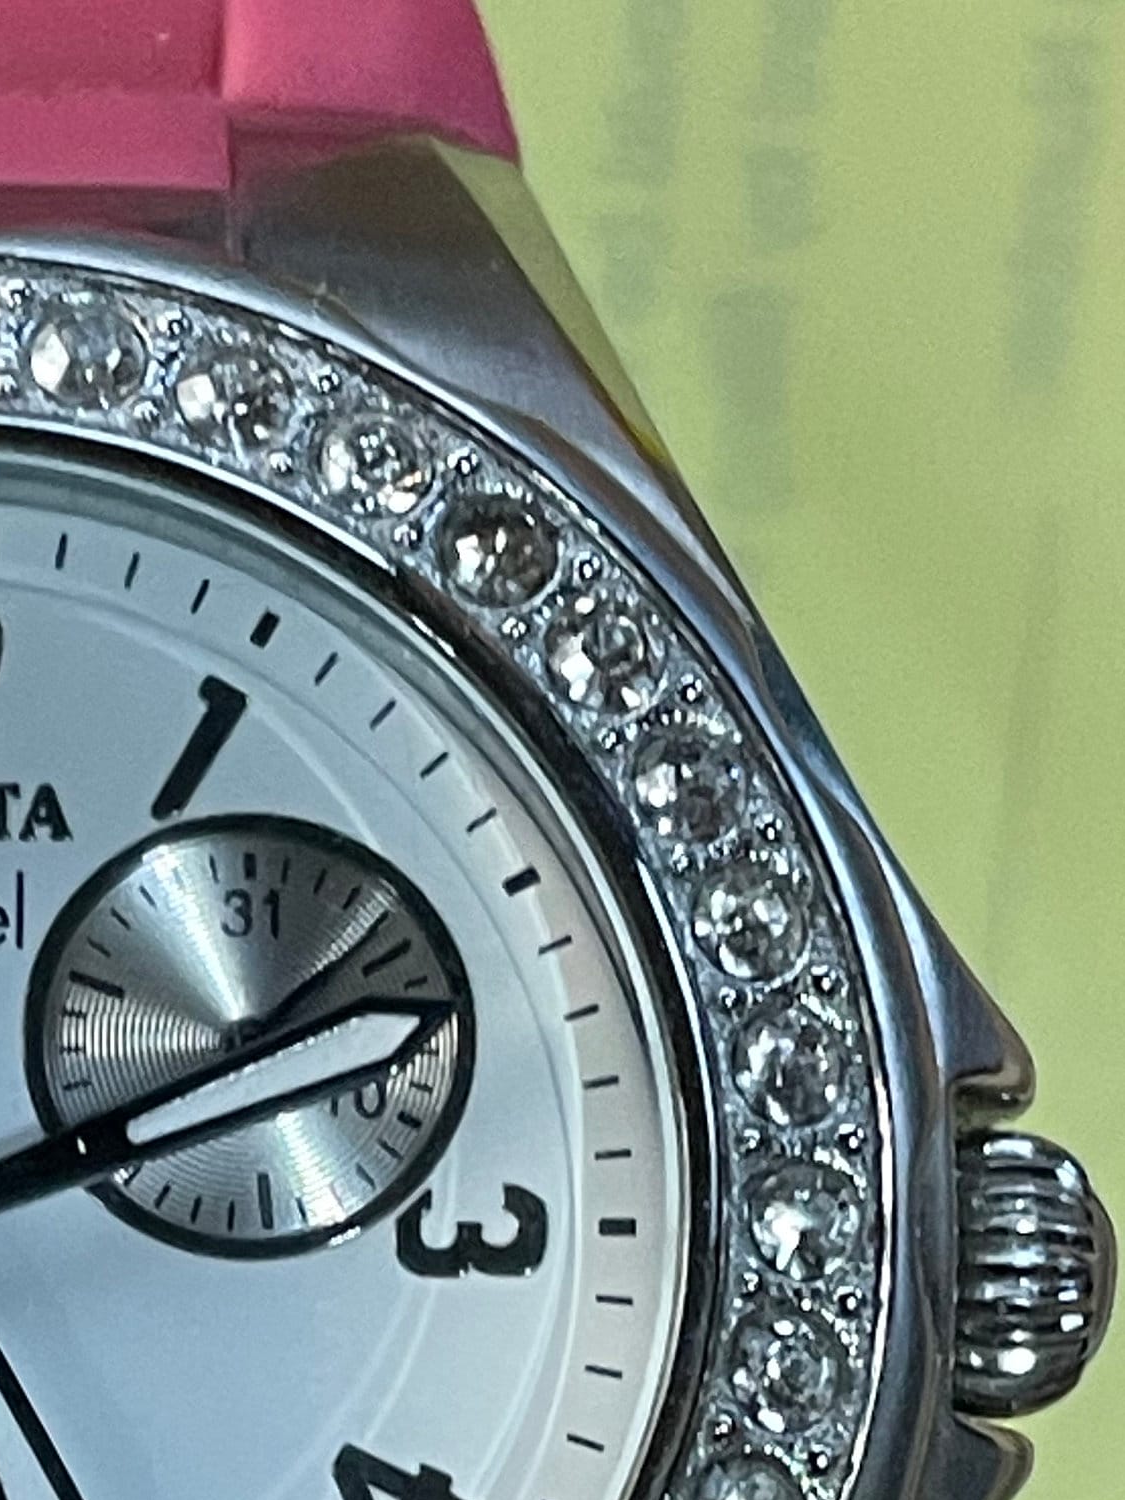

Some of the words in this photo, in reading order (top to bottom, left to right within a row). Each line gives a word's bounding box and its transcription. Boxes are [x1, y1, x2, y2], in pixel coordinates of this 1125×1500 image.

[151, 674, 247, 821] 1
[221, 888, 282, 940] 31
[395, 1183, 548, 1277] 3
